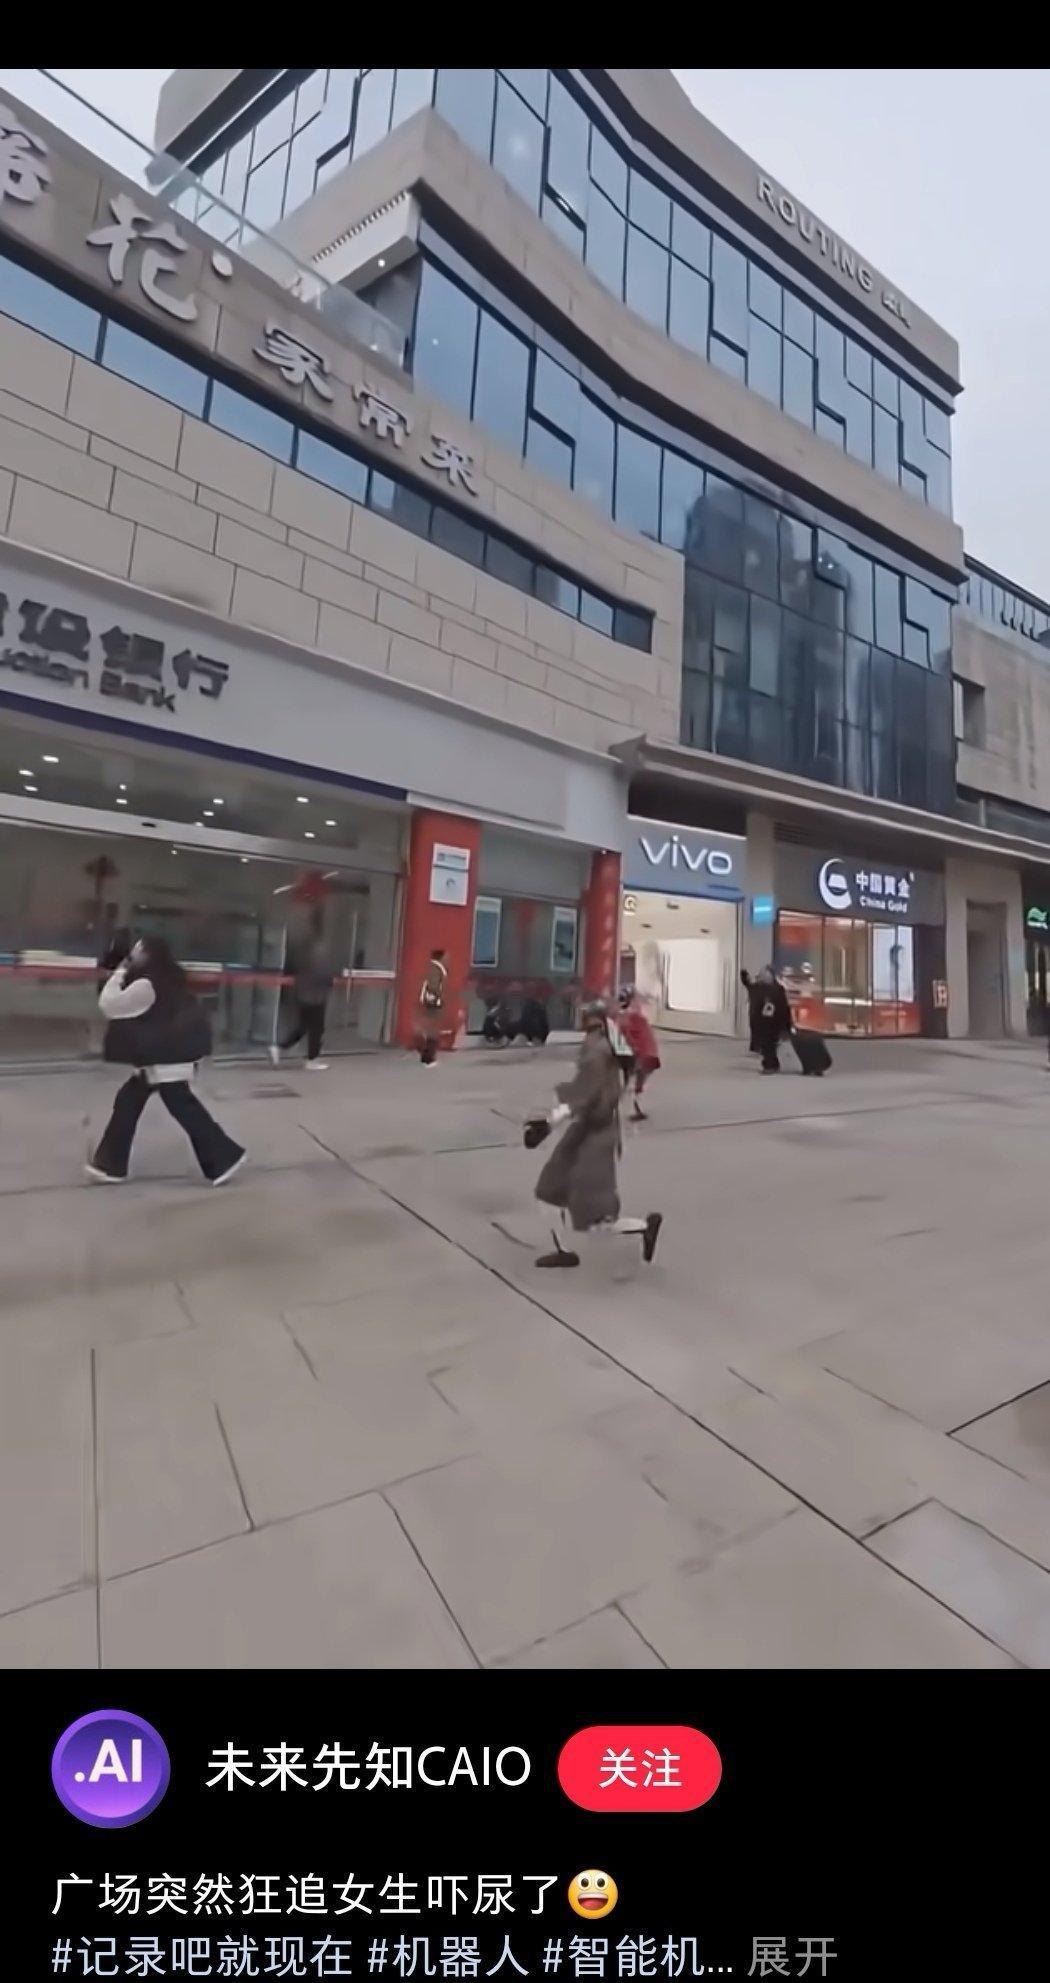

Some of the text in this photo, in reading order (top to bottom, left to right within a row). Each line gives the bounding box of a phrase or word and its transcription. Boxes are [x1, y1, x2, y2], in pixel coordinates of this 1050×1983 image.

[757, 175, 873, 293] ROUTING
[0, 592, 229, 699] 设银行
[640, 835, 733, 875] vivo
